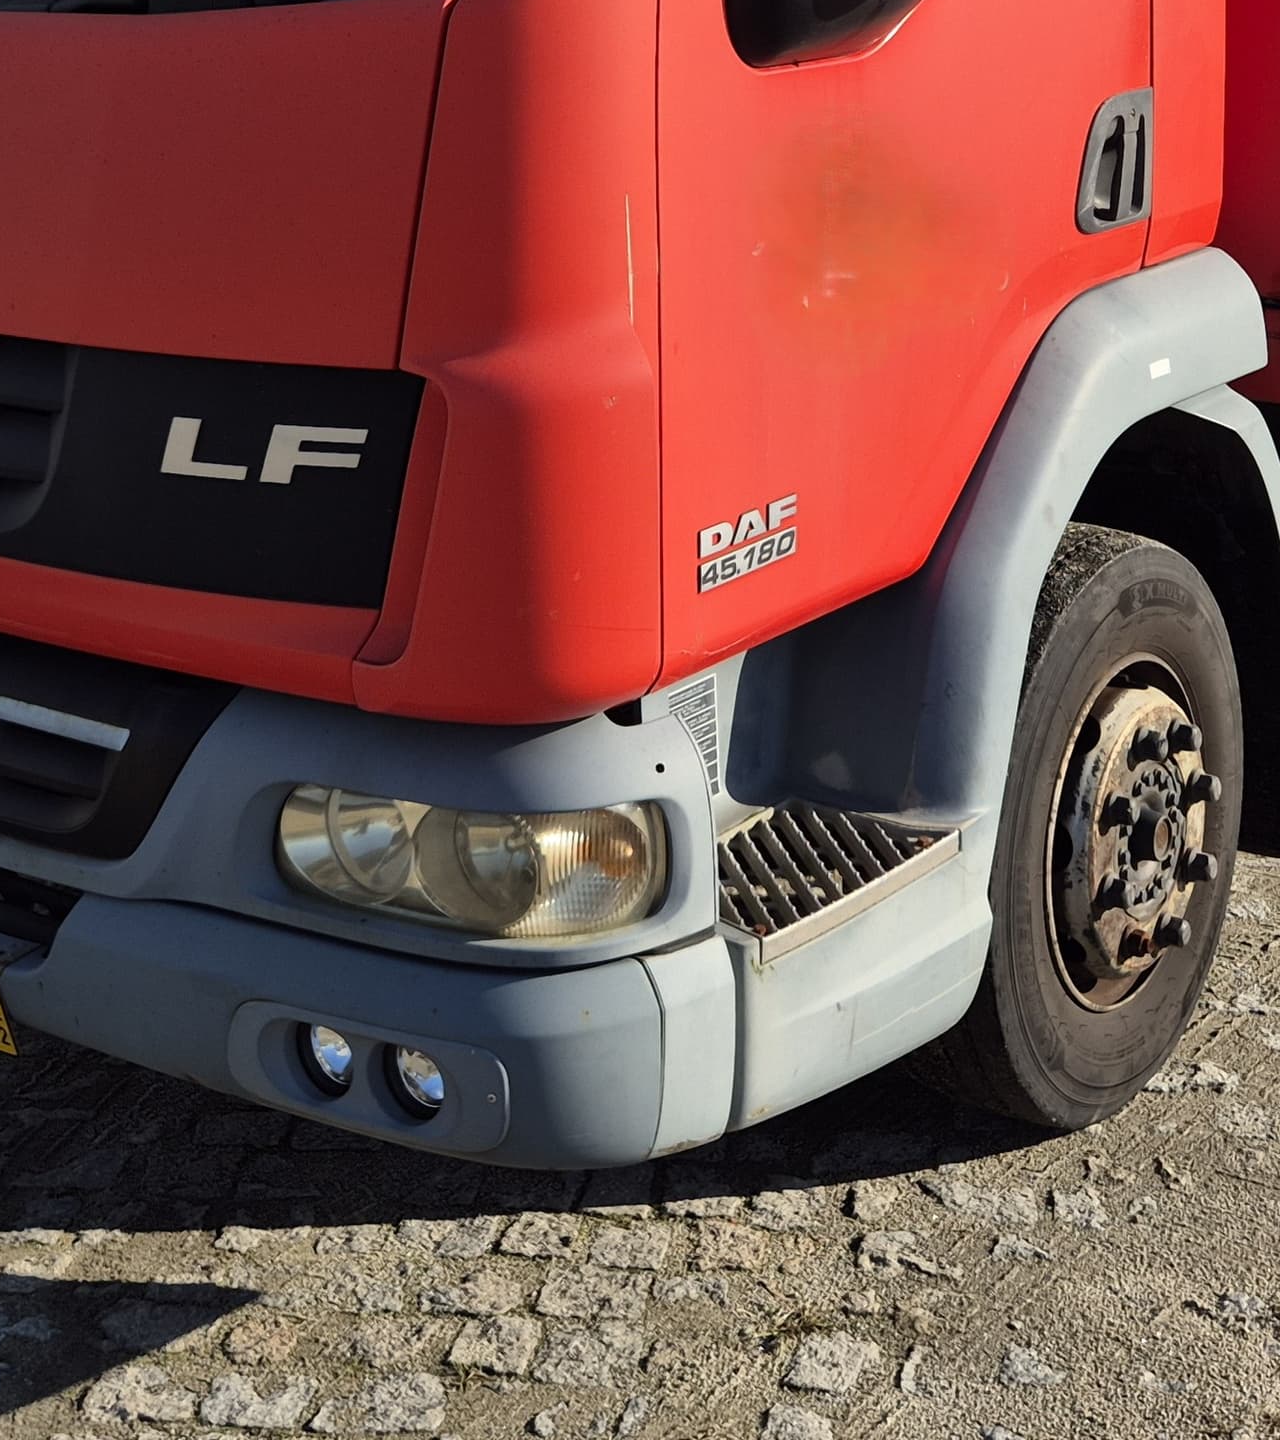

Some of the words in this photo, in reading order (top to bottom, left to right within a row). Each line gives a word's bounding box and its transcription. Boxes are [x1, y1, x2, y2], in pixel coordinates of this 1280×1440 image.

[160, 417, 368, 484] LF
[699, 493, 797, 559] DAF
[702, 530, 795, 585] 45.180
